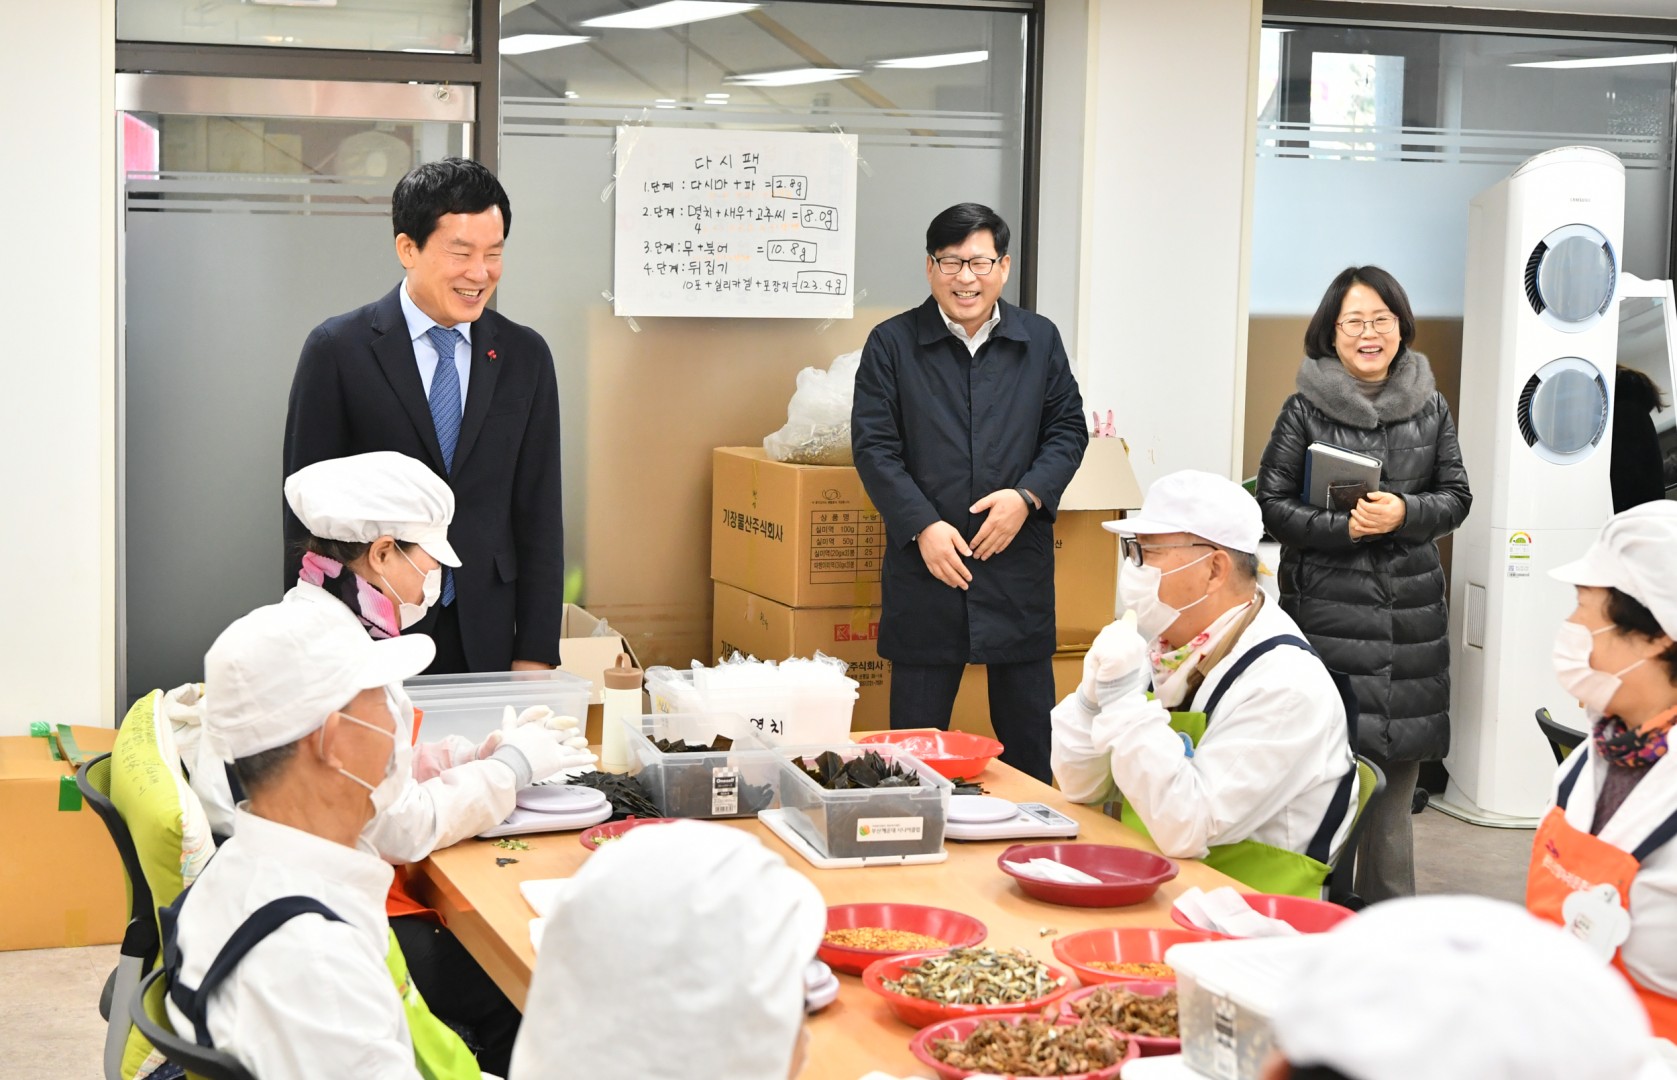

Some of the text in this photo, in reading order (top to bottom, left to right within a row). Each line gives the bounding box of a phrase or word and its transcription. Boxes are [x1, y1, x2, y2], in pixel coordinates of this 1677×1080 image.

[775, 178, 802, 197] 2.8g
[804, 209, 833, 230] 8.0g
[771, 242, 806, 262] 10.8g
[687, 259, 728, 276] 뒤집기
[722, 508, 784, 543] 기장물산주식회사
[840, 526, 855, 534] 100g
[865, 525, 874, 533] 20
[842, 537, 854, 545] 50g
[864, 560, 873, 568] 40
[847, 661, 884, 672] 주식회사
